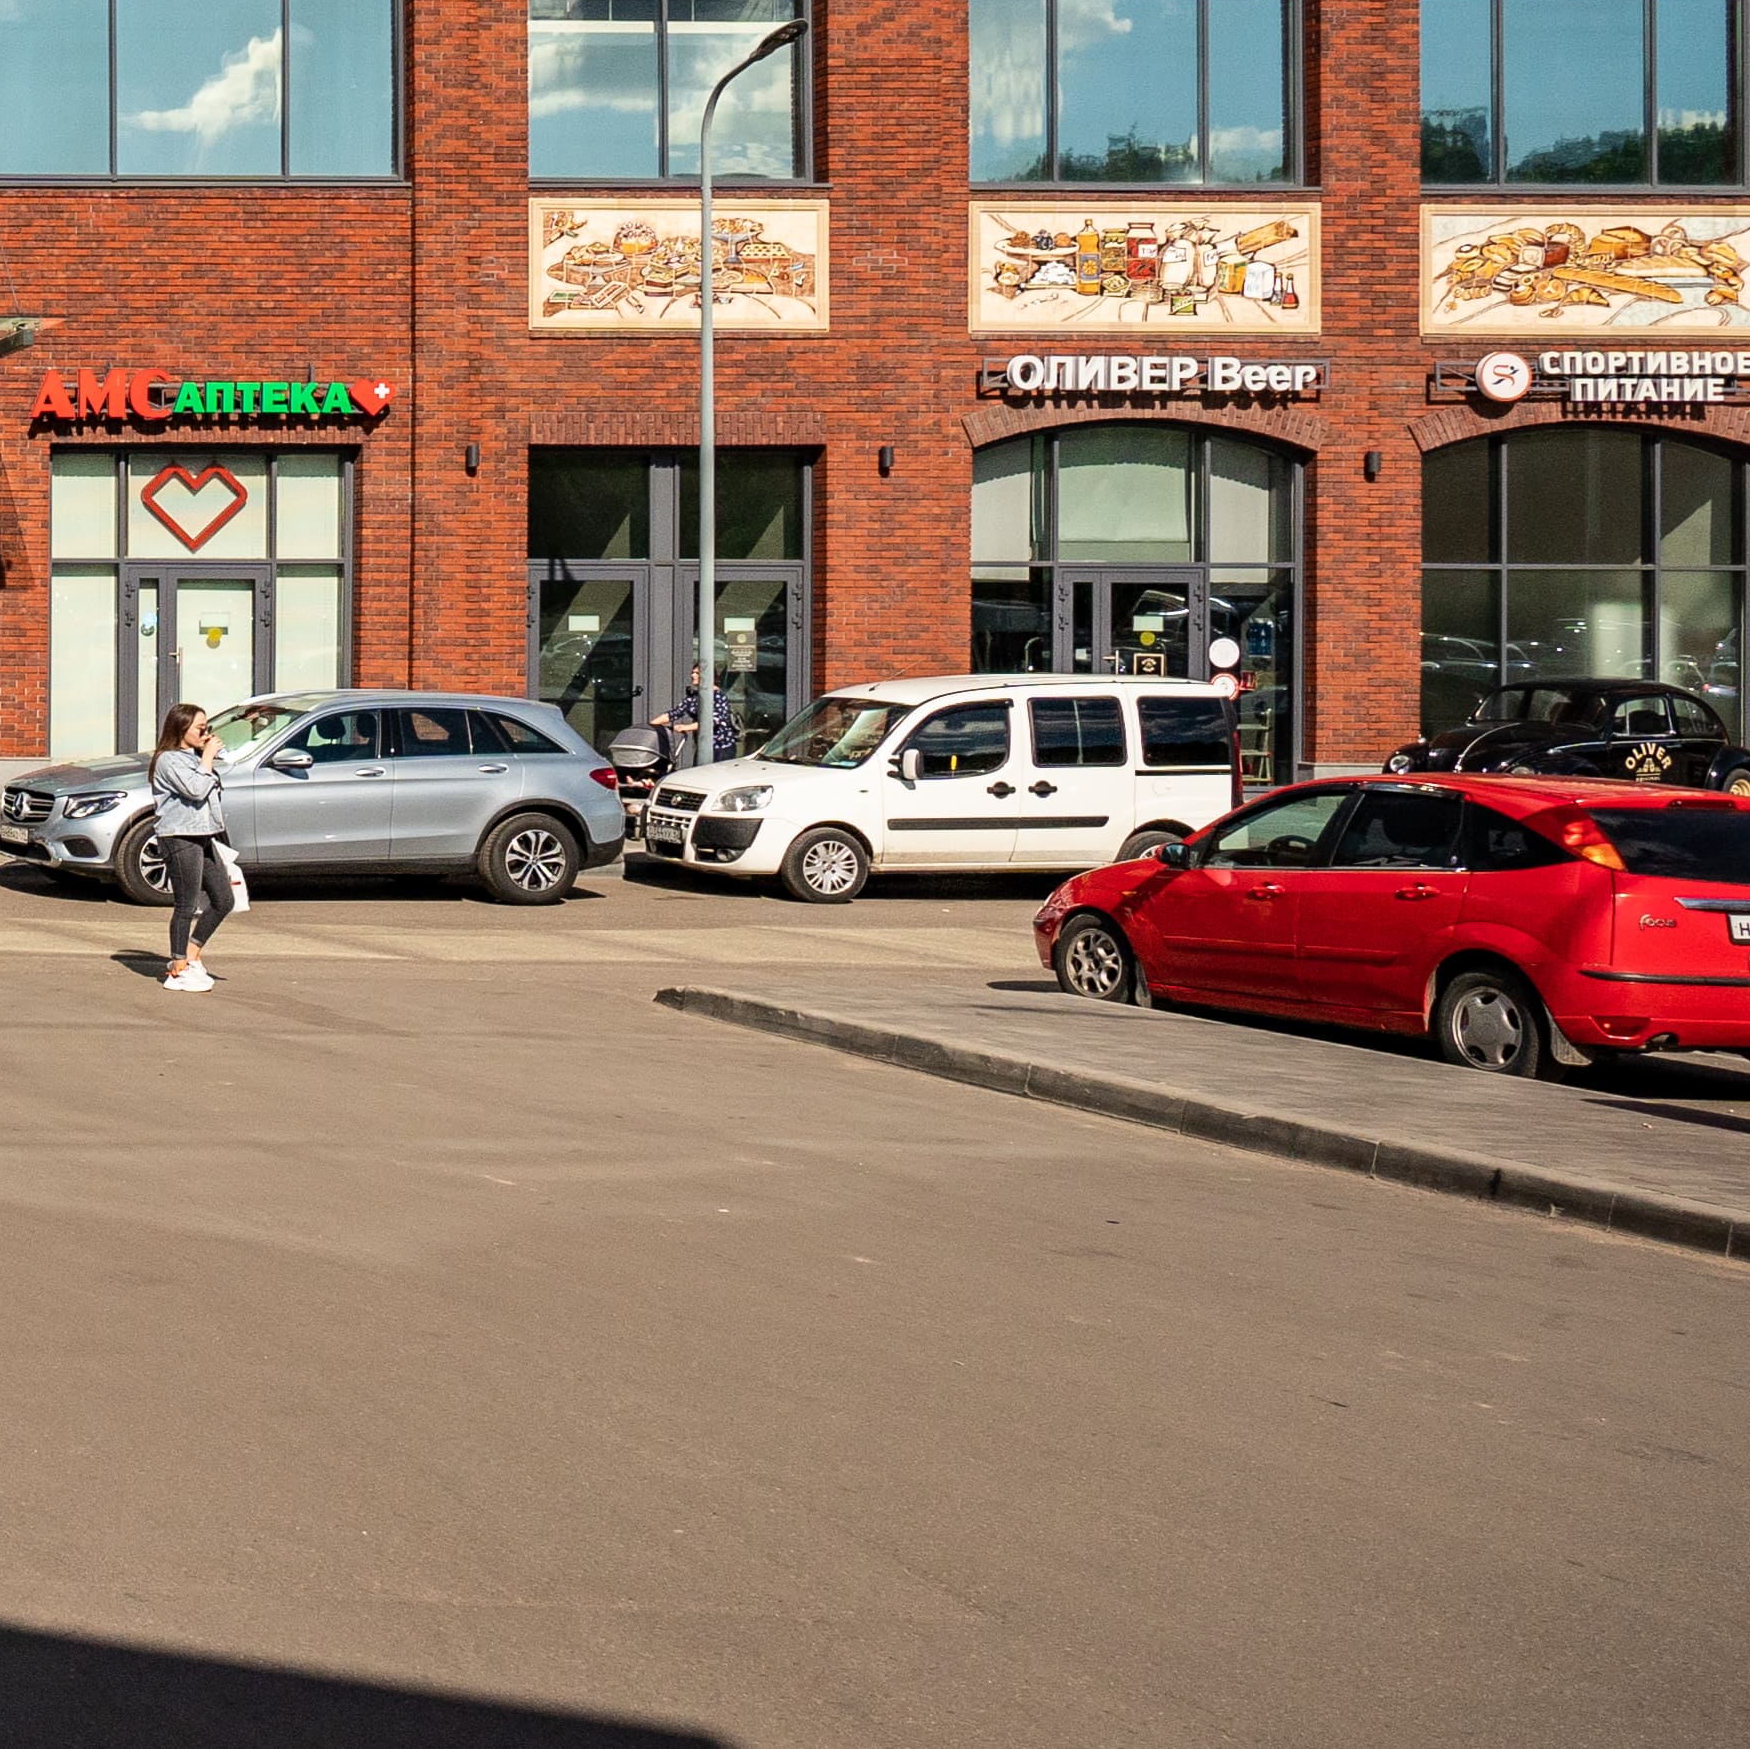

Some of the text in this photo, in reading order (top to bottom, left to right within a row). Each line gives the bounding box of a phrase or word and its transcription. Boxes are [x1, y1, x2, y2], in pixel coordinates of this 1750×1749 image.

[1007, 354, 1318, 392] ОЛИВЕР Beer
[172, 381, 353, 414] АПТЕКА
[1570, 377, 1725, 401] ПИТАНИЕ
[1624, 742, 1672, 770] OLIVER
